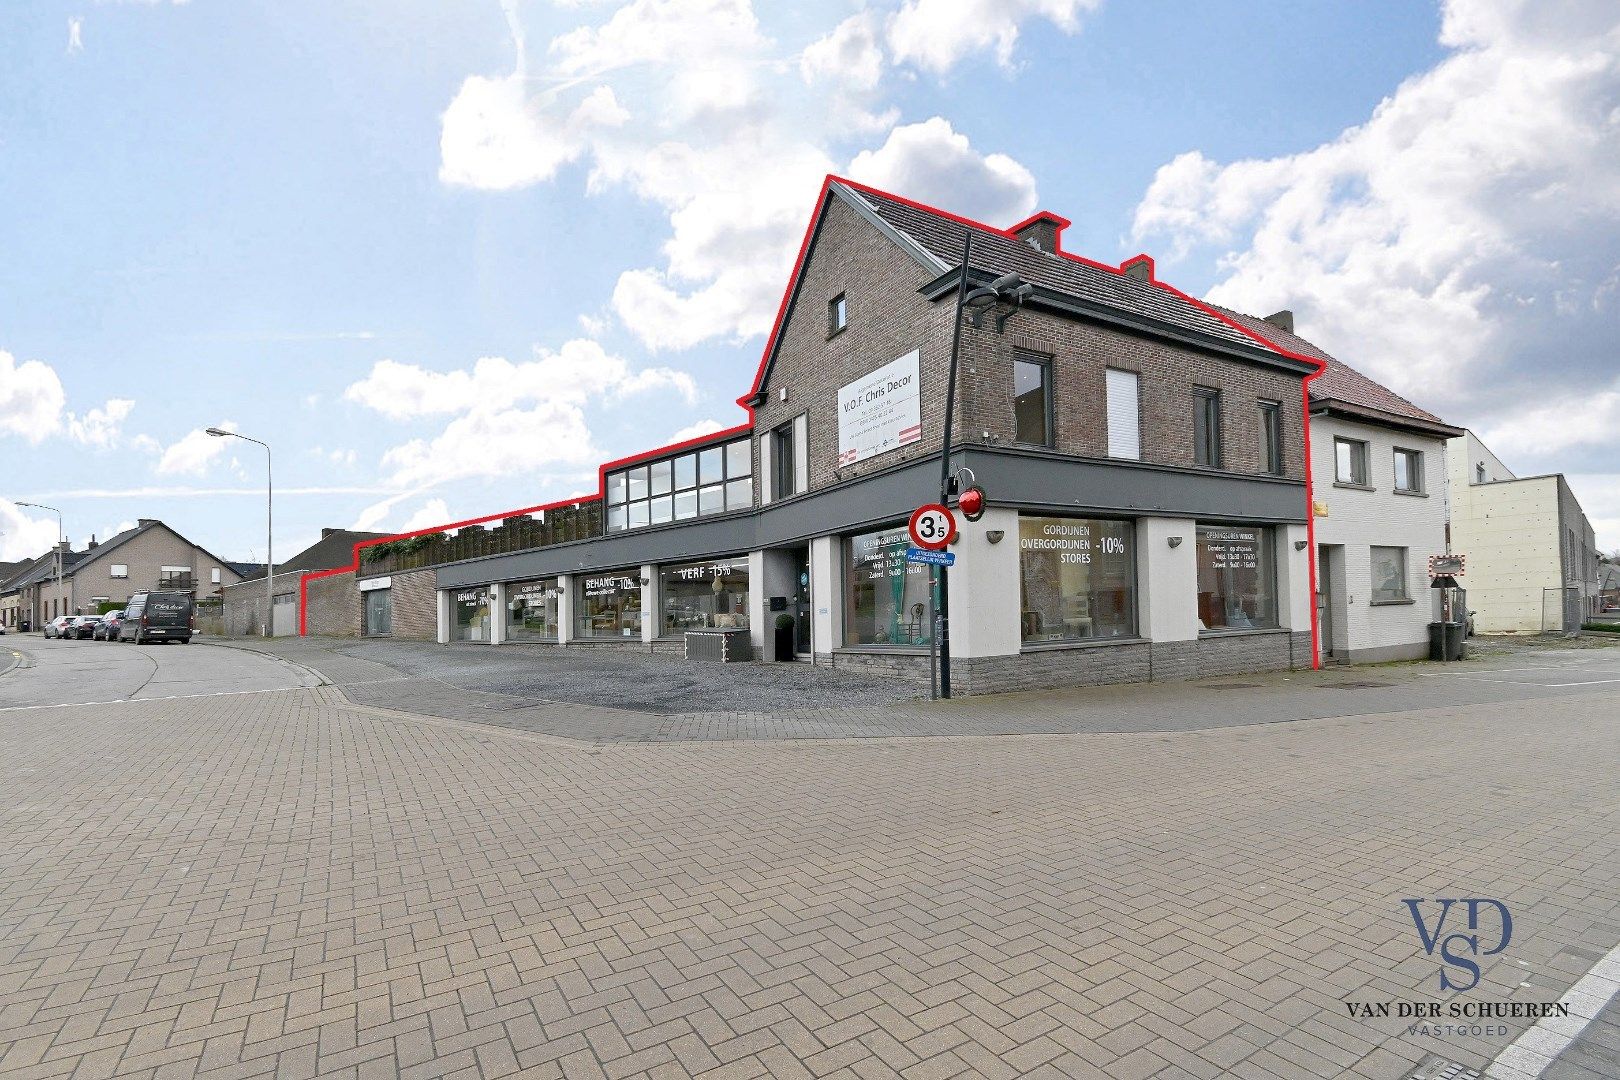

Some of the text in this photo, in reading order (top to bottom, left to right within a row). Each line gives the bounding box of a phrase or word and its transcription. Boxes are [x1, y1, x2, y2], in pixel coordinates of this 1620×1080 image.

[843, 396, 864, 413] V.O.F.
[865, 386, 885, 403] Chris
[887, 374, 912, 393] Decor
[921, 516, 945, 538] 3 5
[1043, 524, 1090, 536] GORDIJNEN
[1020, 538, 1091, 550] OVERGORDIJNEN
[1095, 537, 1124, 554] -10%
[1060, 553, 1091, 564] STORES
[681, 566, 705, 580] VERF
[708, 564, 731, 577] -15%
[585, 576, 615, 590] BEHANG
[457, 591, 477, 602] BEHANG
